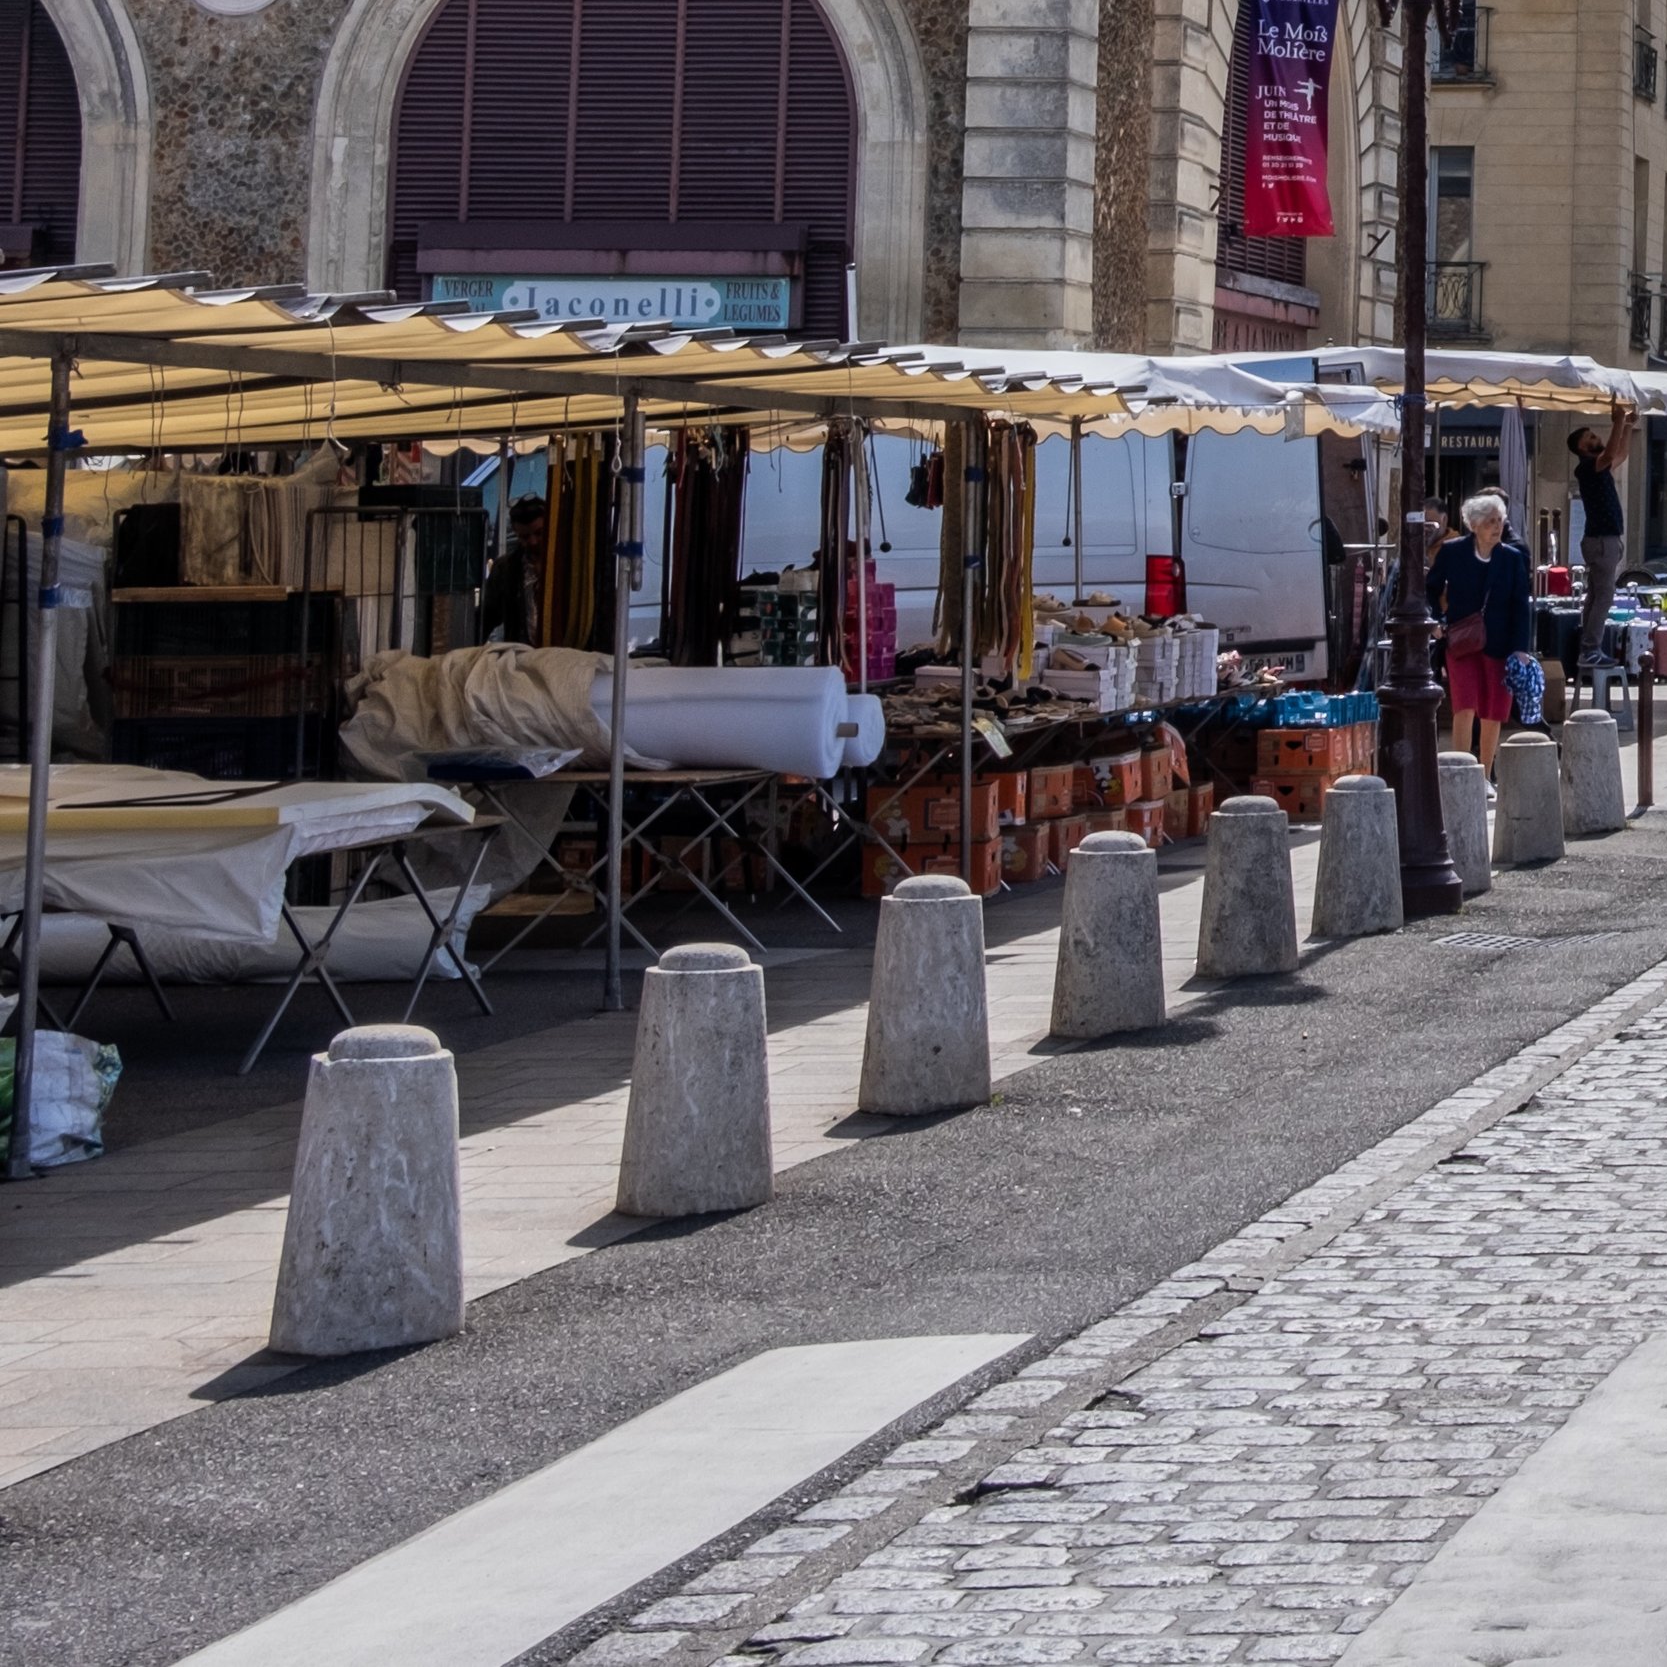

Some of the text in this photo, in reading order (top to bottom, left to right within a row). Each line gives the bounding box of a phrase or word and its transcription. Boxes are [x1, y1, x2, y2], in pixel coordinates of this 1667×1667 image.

[1257, 18, 1328, 43] Le Mois
[1255, 85, 1287, 100] JUIN
[1279, 100, 1299, 111] MOIS
[1264, 110, 1277, 119] DE
[1263, 121, 1290, 130] ET DE
[443, 280, 494, 298] VERGER
[726, 282, 781, 300] FRUITS &
[1440, 435, 1501, 448] RESTAURA
